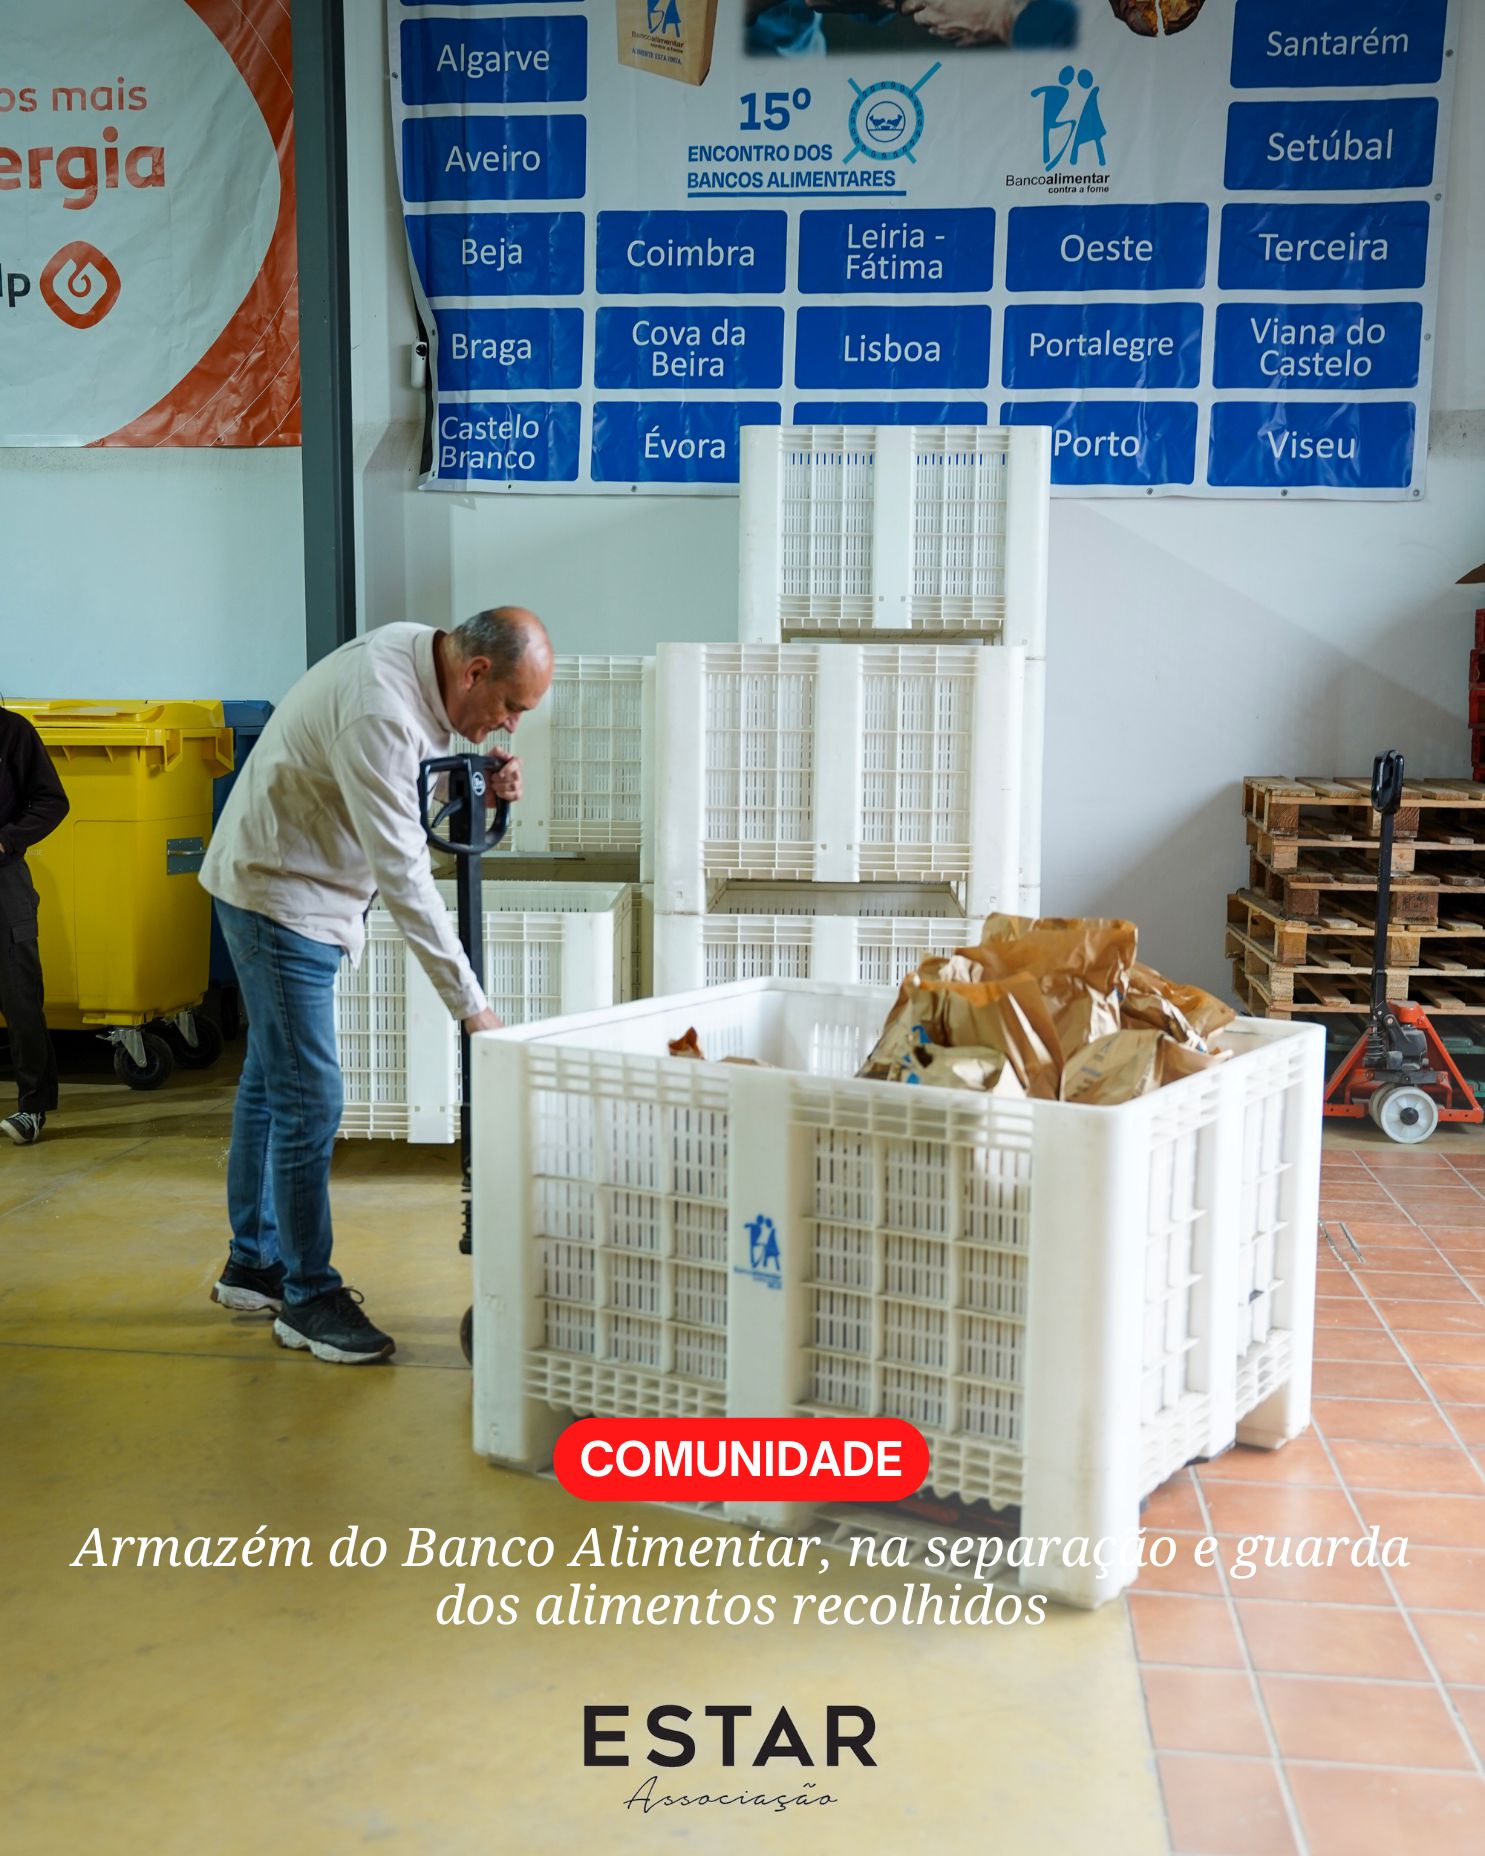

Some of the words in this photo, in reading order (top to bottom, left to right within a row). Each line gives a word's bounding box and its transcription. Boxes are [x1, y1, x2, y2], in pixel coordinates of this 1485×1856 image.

[1267, 27, 1408, 56] Santarém
[437, 44, 549, 78] Algarve
[52, 77, 148, 111] mais
[446, 145, 540, 171] Aveiro
[688, 145, 789, 162] ENCONTRO
[794, 144, 832, 161] DOS
[1268, 129, 1392, 161] Setúbal
[688, 172, 763, 188] BANCOS
[767, 170, 895, 187] ALIMENTARES
[1006, 173, 1110, 187] Bancoalimentar
[1048, 185, 1077, 195] contra
[1086, 183, 1110, 194] fome
[848, 223, 924, 248] Leiria
[1061, 235, 1152, 261] Oeste
[1259, 232, 1387, 261] Terceira
[463, 238, 521, 271] Beja
[627, 238, 754, 266] Coimbra
[847, 253, 942, 279] Fátima
[633, 321, 700, 345] Cova
[712, 319, 745, 345] da
[1251, 318, 1334, 344] Viana
[1347, 318, 1385, 344] do
[453, 334, 531, 365] Braga
[845, 334, 940, 362] Lisboa
[1031, 330, 1173, 361] Portalegre
[653, 351, 723, 376] Beira
[1261, 349, 1371, 376] Castelo
[441, 413, 539, 440] Castelo
[645, 426, 725, 458] Évora
[1055, 430, 1141, 457] Porto
[1267, 430, 1355, 459] Viseu
[440, 445, 536, 470] Branco
